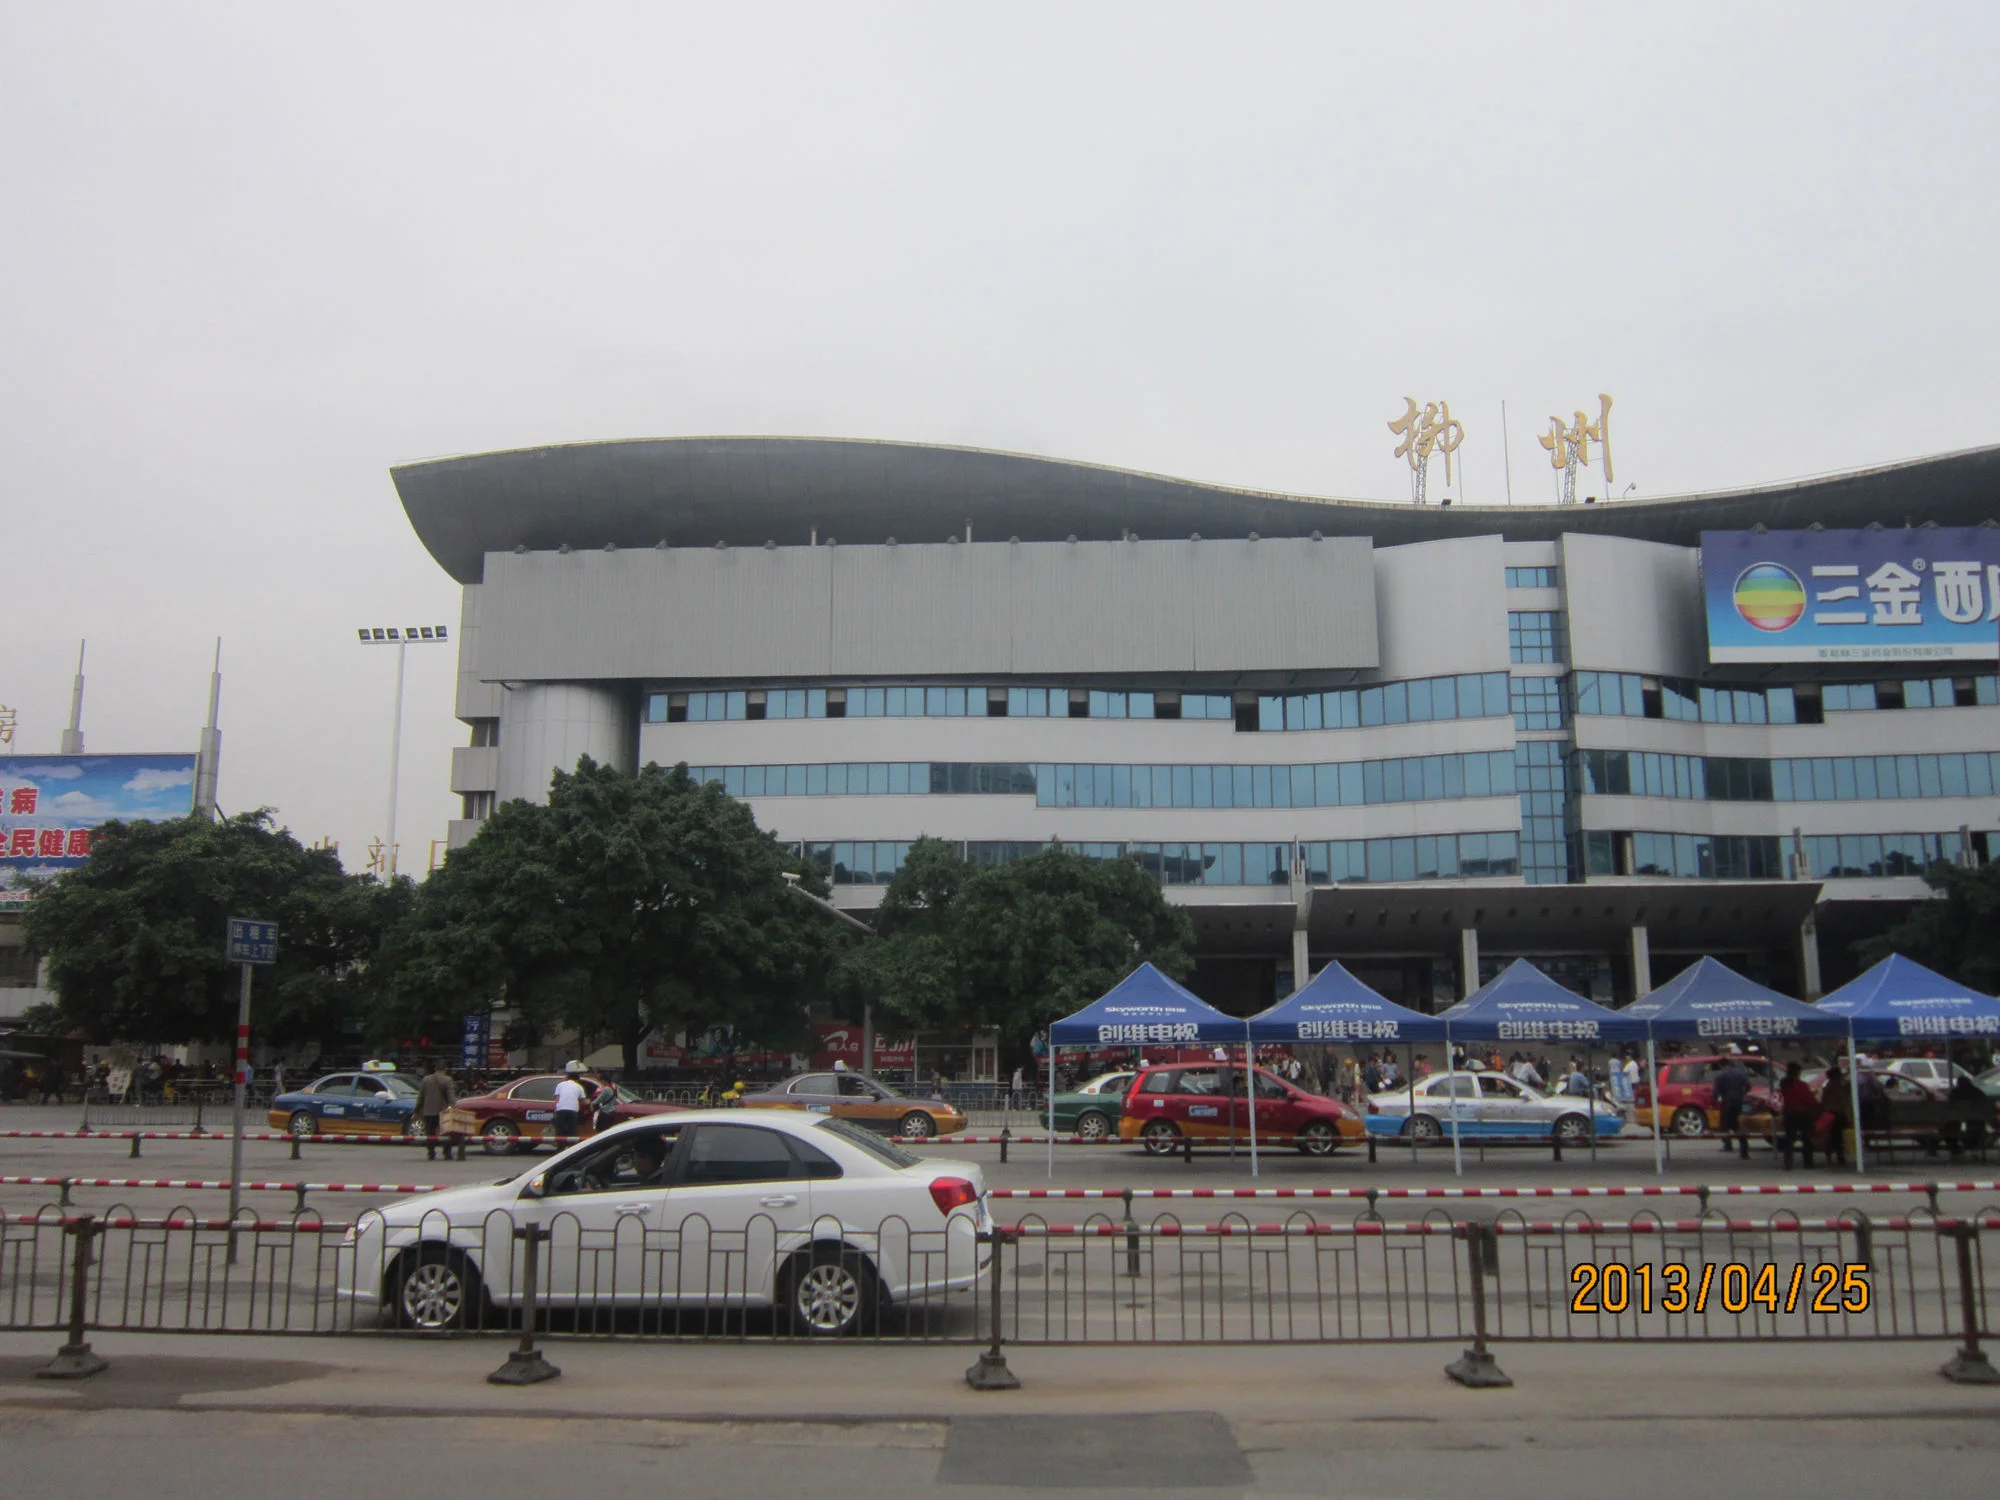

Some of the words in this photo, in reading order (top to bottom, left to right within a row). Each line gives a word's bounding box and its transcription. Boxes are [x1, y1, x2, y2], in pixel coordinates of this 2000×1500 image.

[1387, 393, 1614, 487] 柳州
[0, 787, 39, 815] 病
[1098, 1022, 1200, 1042] 创维电视
[1297, 1020, 1400, 1040] 创维电视
[1497, 1020, 1601, 1039] 创维电视
[1696, 1016, 1800, 1036] 创维电视
